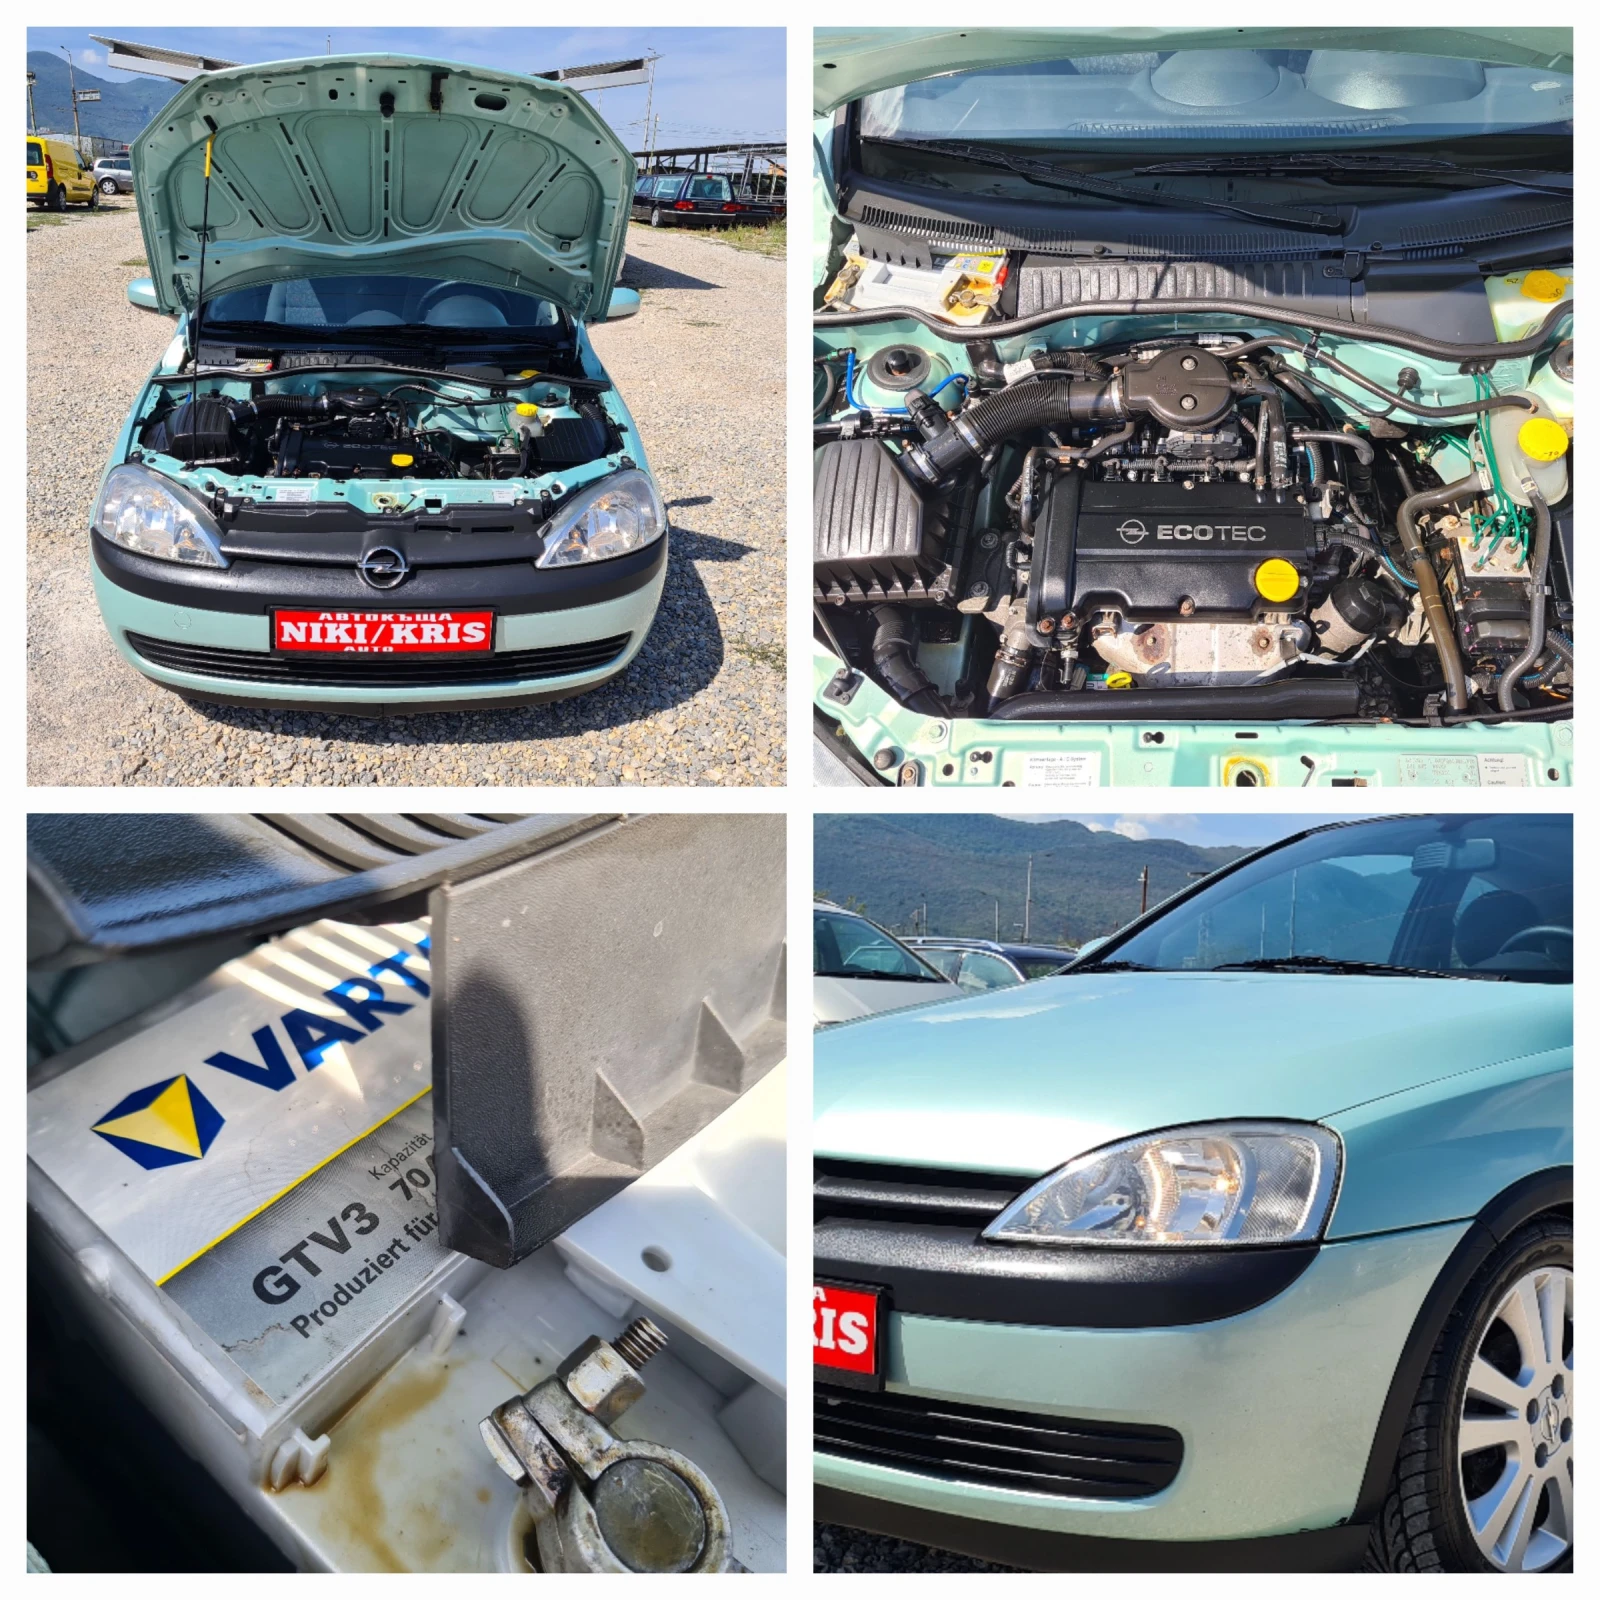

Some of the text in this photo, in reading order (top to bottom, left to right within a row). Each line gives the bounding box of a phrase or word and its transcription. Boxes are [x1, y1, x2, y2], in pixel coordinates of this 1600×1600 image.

[1157, 524, 1267, 542] ECOTEC
[280, 621, 486, 644] NIKI/KRIS
[203, 933, 431, 1092] VART
[368, 1133, 433, 1180] Kapazität
[252, 1202, 380, 1305] GTV3
[290, 1212, 438, 1339] Produziert für
